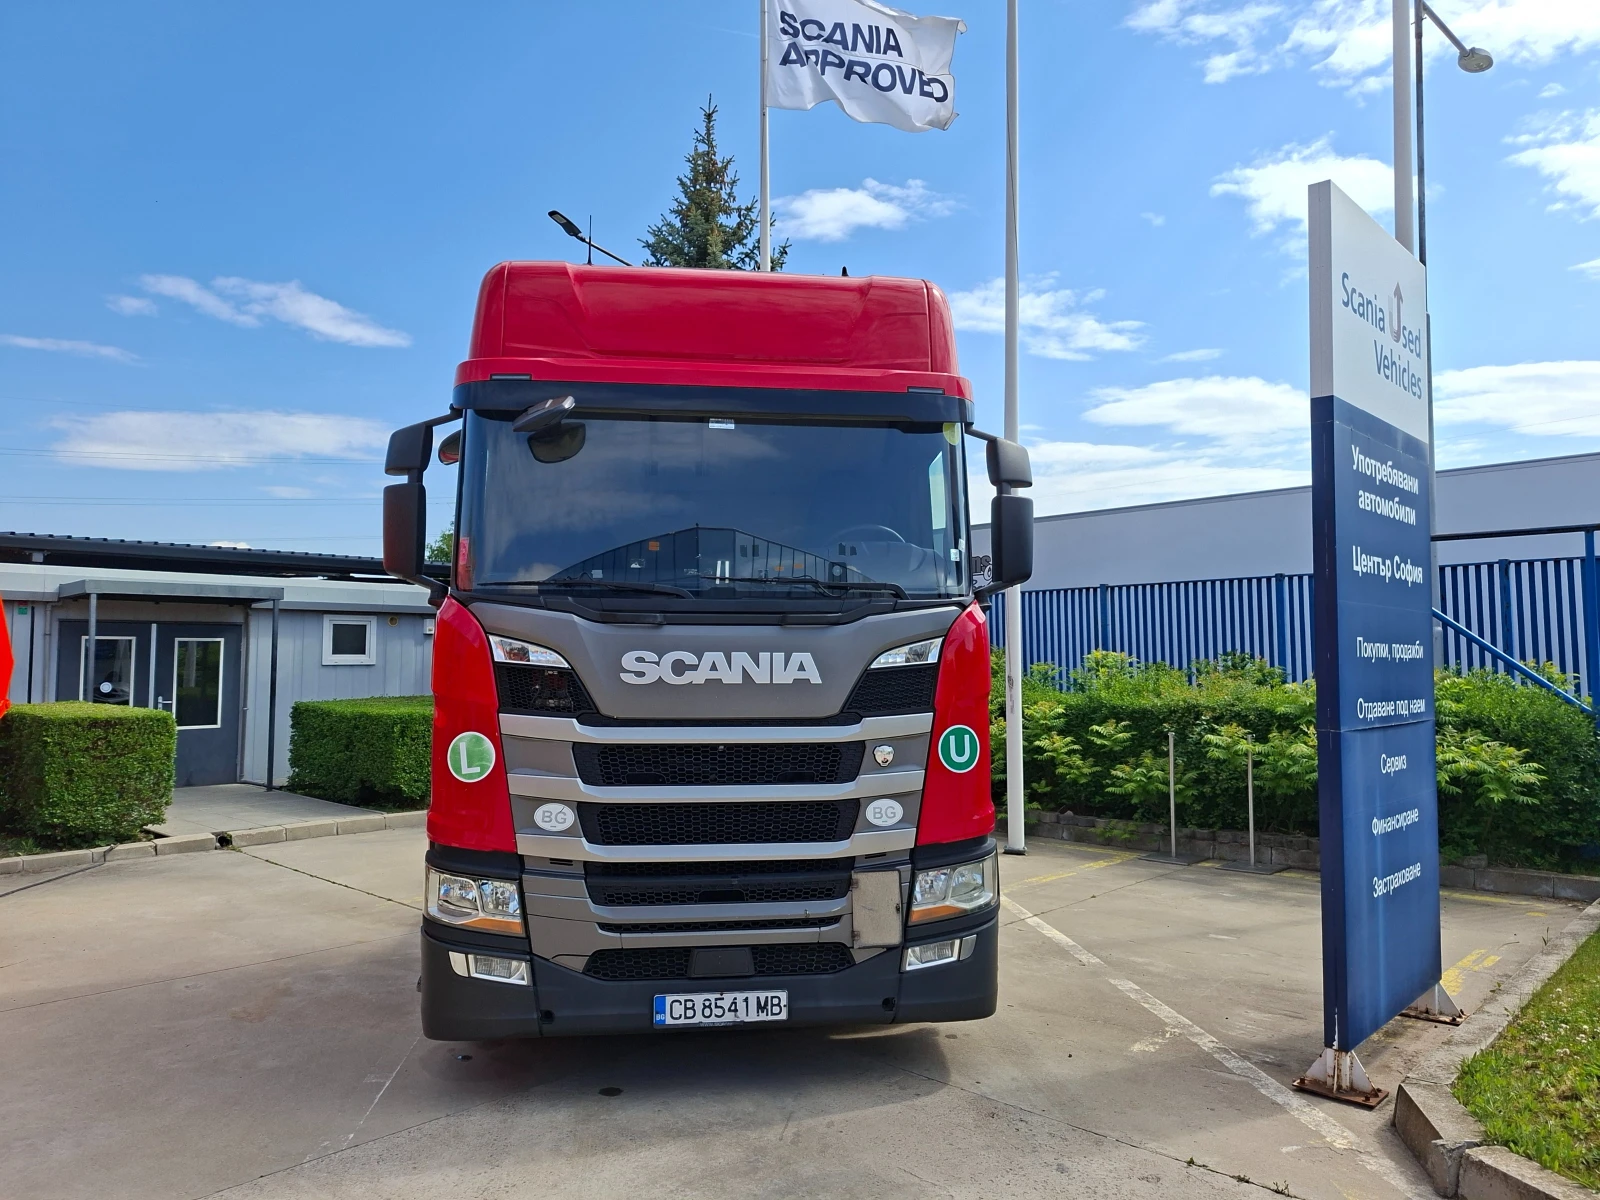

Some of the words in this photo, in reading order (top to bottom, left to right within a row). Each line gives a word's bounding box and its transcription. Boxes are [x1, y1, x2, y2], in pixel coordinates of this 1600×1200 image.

[779, 10, 904, 58] SCANIA
[779, 41, 949, 102] APPROVED
[1341, 271, 1386, 334] Scania
[1374, 339, 1422, 400] Vehicles
[1351, 444, 1419, 495] Употребявани
[1358, 489, 1416, 526] автомобили
[1352, 545, 1391, 583] Център
[1393, 555, 1423, 588] София
[1356, 636, 1391, 663] Покупки,
[1392, 640, 1424, 662] продажби
[619, 650, 823, 685] SCANIA
[1357, 697, 1395, 721] Отдаване
[1396, 700, 1408, 717] под
[1409, 698, 1426, 713] наем
[459, 741, 481, 775] L
[949, 734, 971, 763] U
[1380, 753, 1407, 777] Сервиз
[541, 809, 567, 825] BG
[872, 805, 897, 820] BG
[1371, 808, 1419, 836] Финансиране
[1372, 862, 1421, 898] Застраховане
[669, 998, 697, 1021] CB
[701, 996, 749, 1019] 8541
[756, 995, 783, 1017] MB
